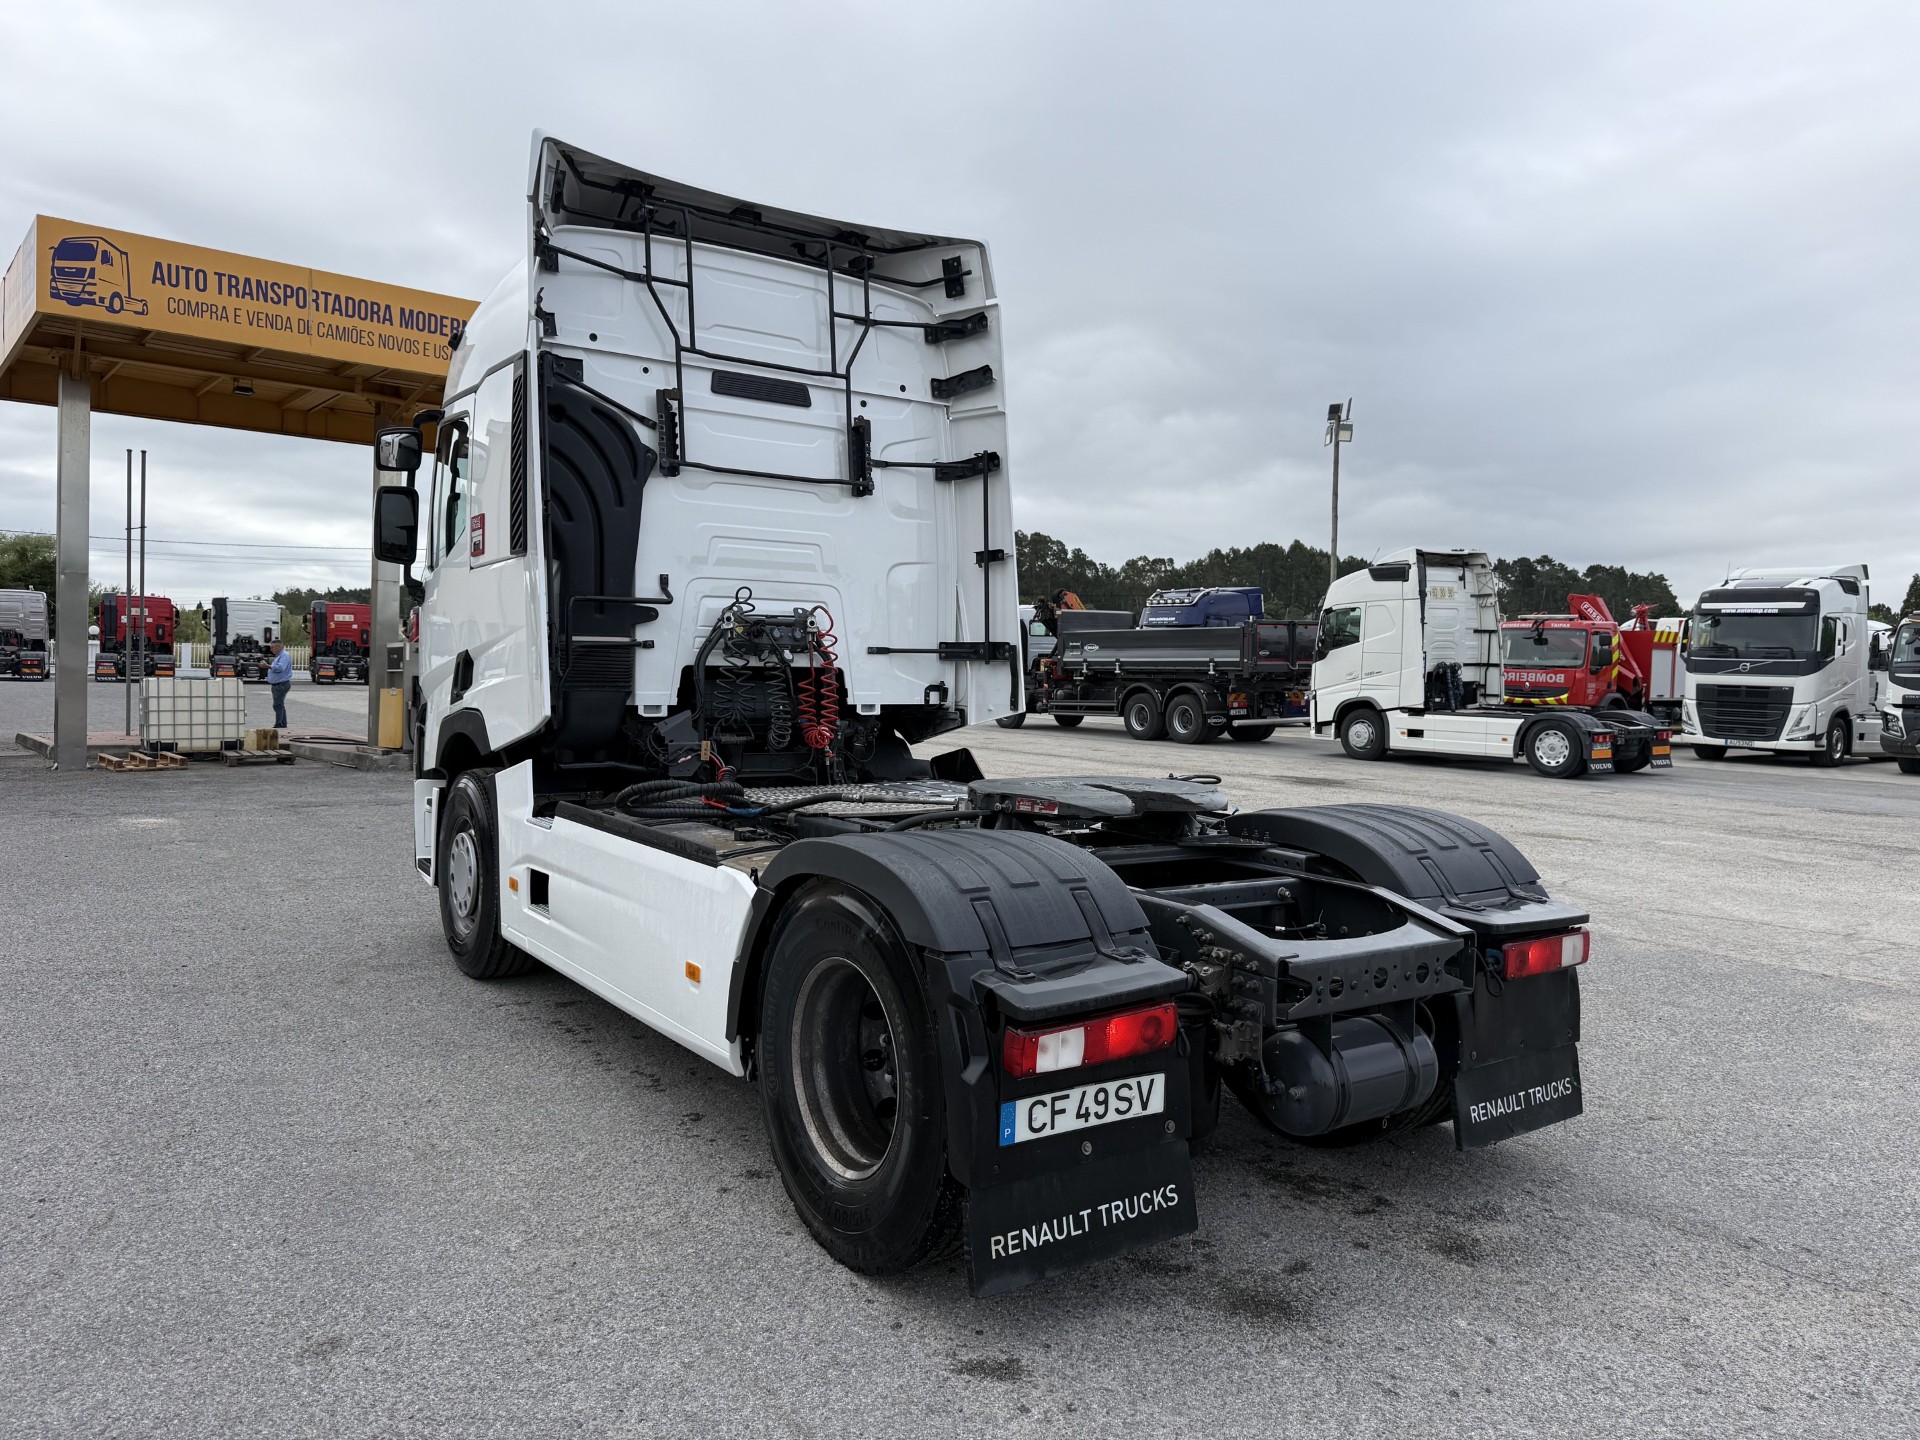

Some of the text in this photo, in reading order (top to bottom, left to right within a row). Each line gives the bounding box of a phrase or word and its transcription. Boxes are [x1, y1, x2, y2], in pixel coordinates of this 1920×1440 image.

[151, 261, 208, 293] AUTO
[213, 272, 394, 327] TRANSPORTADORA
[167, 297, 230, 323] COMPRA
[233, 308, 242, 325] E
[246, 309, 294, 333] VENDA
[317, 321, 375, 347] CAMIÕES
[378, 333, 420, 355] NOVOS
[423, 341, 430, 358] E
[1469, 1077, 1572, 1124] RENAULT TRUCKS
[1004, 1128, 1011, 1138] P
[990, 1184, 1179, 1260] RENAULT TRUCKS
